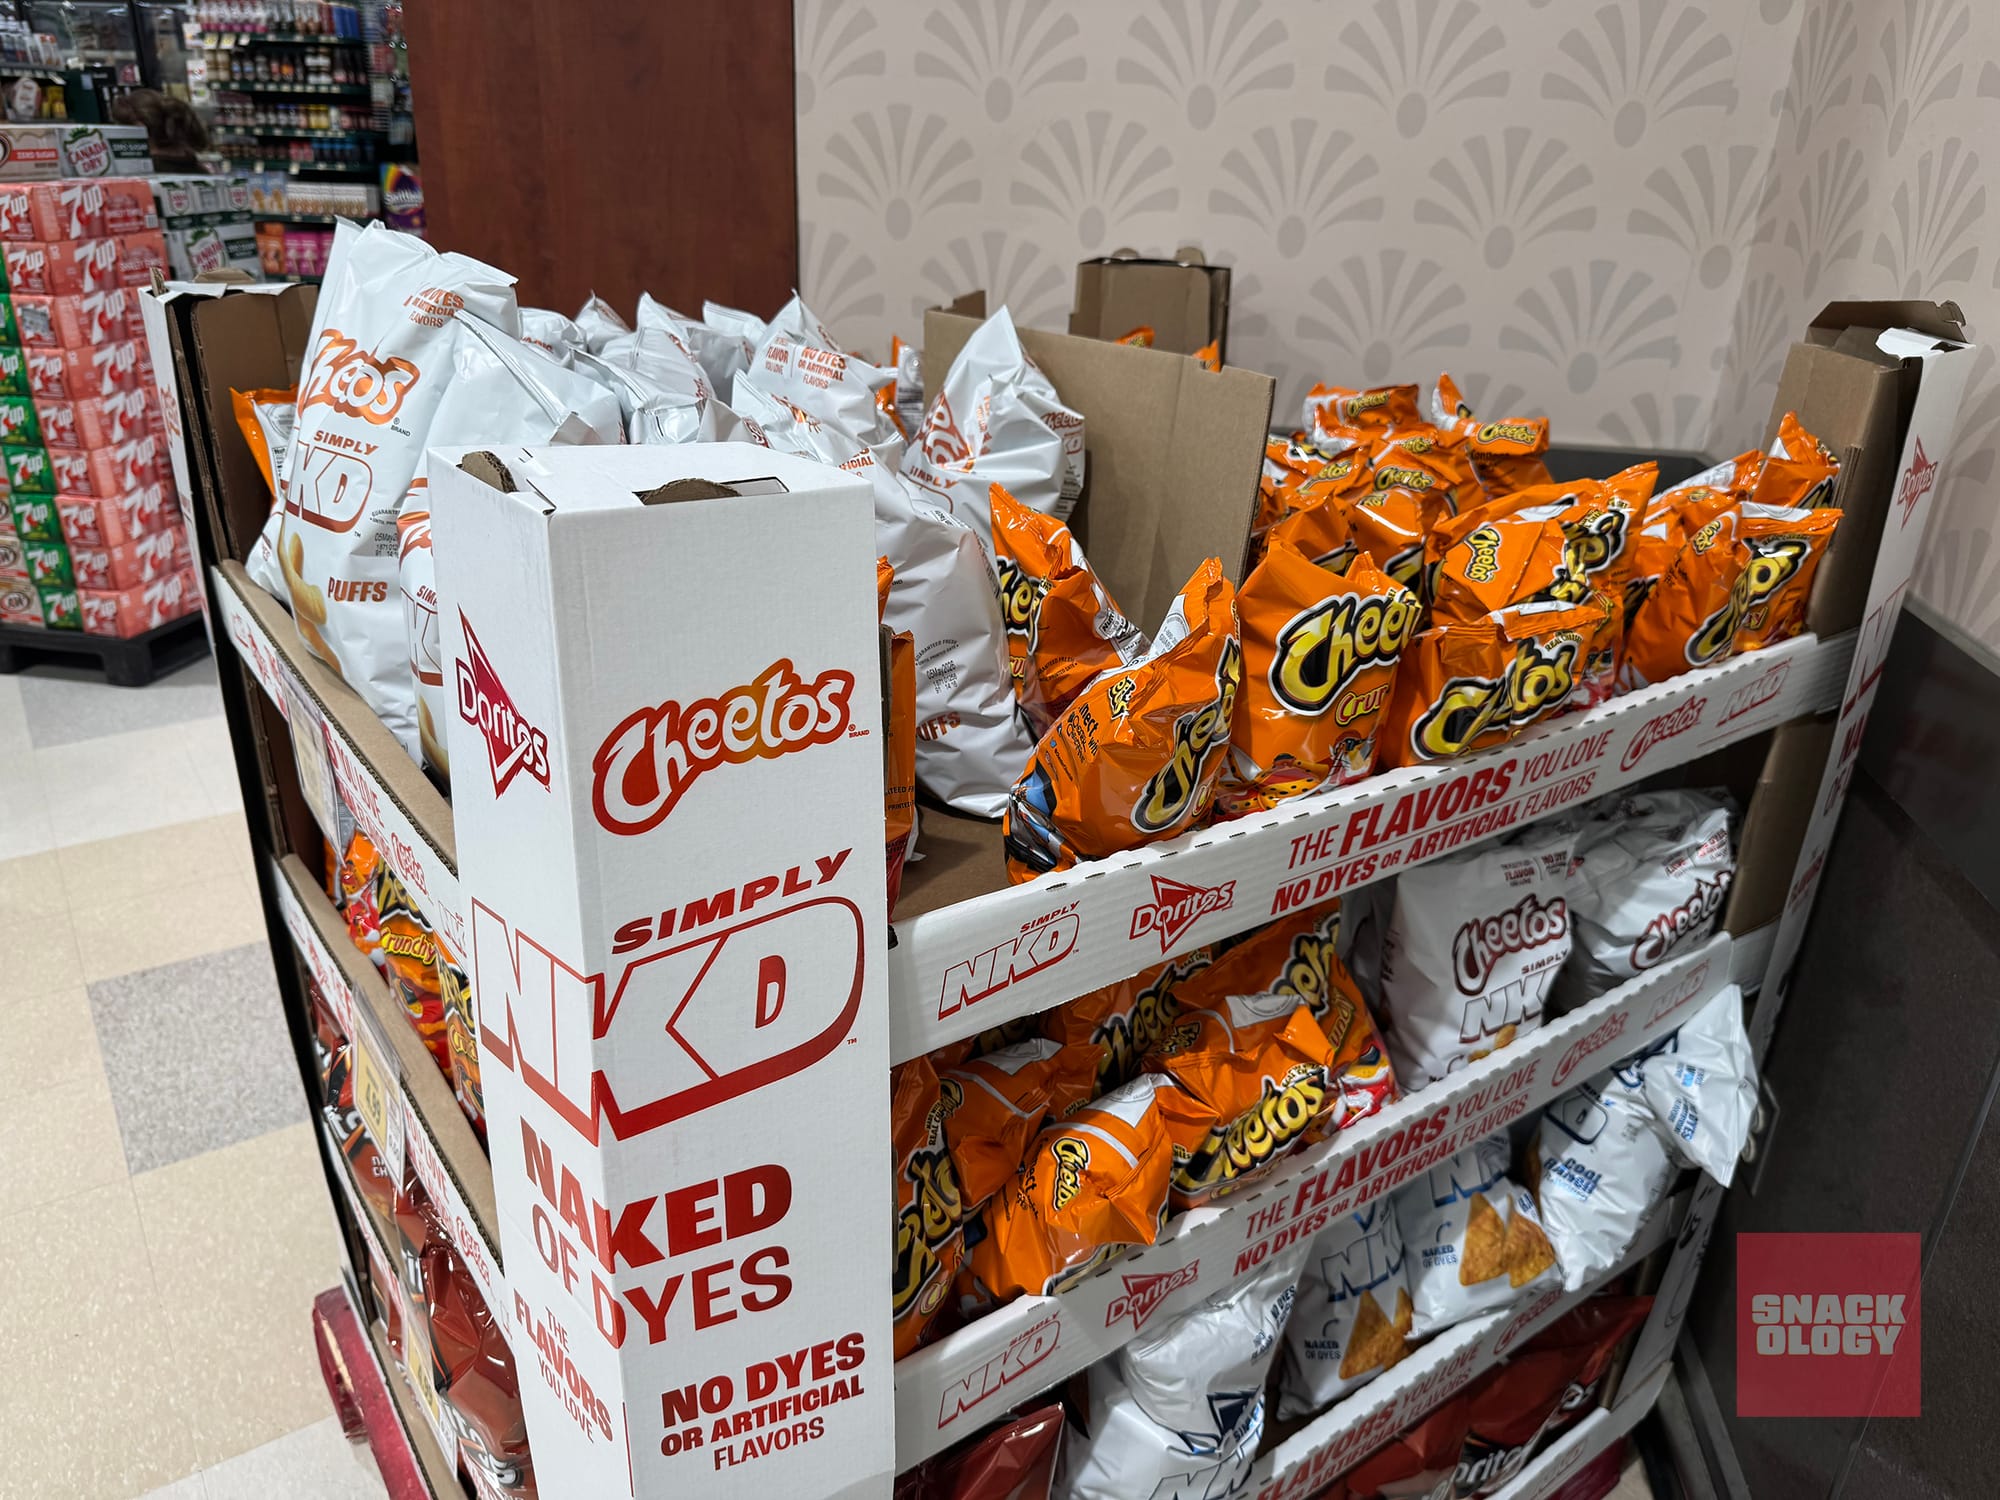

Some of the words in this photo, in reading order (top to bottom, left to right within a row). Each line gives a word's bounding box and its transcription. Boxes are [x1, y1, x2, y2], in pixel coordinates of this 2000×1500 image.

[314, 430, 379, 455] SIMPLY
[1478, 423, 1535, 445] Cheetos
[328, 577, 387, 602] PUFFS
[1467, 528, 1501, 583] Cheetos
[456, 657, 551, 793] Doritos
[593, 658, 856, 836] Cheetos
[849, 729, 870, 738] BRAND
[917, 711, 961, 742] UFFS
[1620, 695, 1708, 773] Cheetos
[1288, 823, 1340, 870] THE
[1336, 758, 1519, 859] FLAVORS
[1520, 750, 1562, 786] YOU
[1561, 730, 1614, 772] LOVE
[1269, 880, 1310, 917] NO
[1312, 853, 1378, 902] DYES
[1380, 846, 1402, 870] OR
[1402, 806, 1519, 866] ARTIFICIAL
[1520, 770, 1598, 824] FLAVORS
[612, 848, 853, 954] SIMPLY
[1019, 900, 1081, 934] SIMPLY
[1129, 880, 1237, 941] Doritos
[938, 913, 1080, 1021] NKD
[1453, 893, 1568, 996] Cheetos
[1521, 948, 1568, 974] SIMPLY
[472, 895, 865, 1146] NKD
[1458, 969, 1549, 1044] NK
[1551, 1010, 1629, 1088] Cheetos
[1233, 1242, 1267, 1277] NO
[1269, 1211, 1327, 1260] DYES
[1331, 1198, 1350, 1219] OR
[1353, 1135, 1457, 1208] ARTIFICIAL
[1459, 1094, 1527, 1151] FLAVORS
[1246, 1203, 1288, 1240] THE
[1294, 1107, 1448, 1217] FLAVORS
[1453, 1086, 1494, 1125] YOU
[1490, 1059, 1541, 1103] LOVE
[519, 1115, 792, 1274] NAKED
[532, 1204, 579, 1295] OF
[591, 1245, 792, 1350] DYES
[1321, 1232, 1404, 1303] NK
[1422, 1244, 1455, 1258] NAKED
[1435, 1253, 1457, 1267] DYES
[545, 1306, 569, 1354] THE
[1009, 1309, 1060, 1347] SIMPLY
[1105, 1258, 1200, 1328] Doritos
[514, 1287, 613, 1442] FLAVORS
[661, 1375, 734, 1429] NO
[745, 1332, 866, 1402] DYES
[938, 1318, 1061, 1430] NKD
[1304, 1338, 1339, 1350] NAKED
[1318, 1348, 1342, 1361] DYES
[1404, 1372, 1435, 1409] YOU
[1435, 1342, 1481, 1388] LOVE
[537, 1353, 561, 1402] YOU
[564, 1396, 594, 1444] LOVE
[661, 1426, 704, 1457] OR
[710, 1375, 865, 1443] ARTIFICIAL
[713, 1417, 825, 1471] FLAVORS
[1307, 1419, 1403, 1495] ARTIFICIAL
